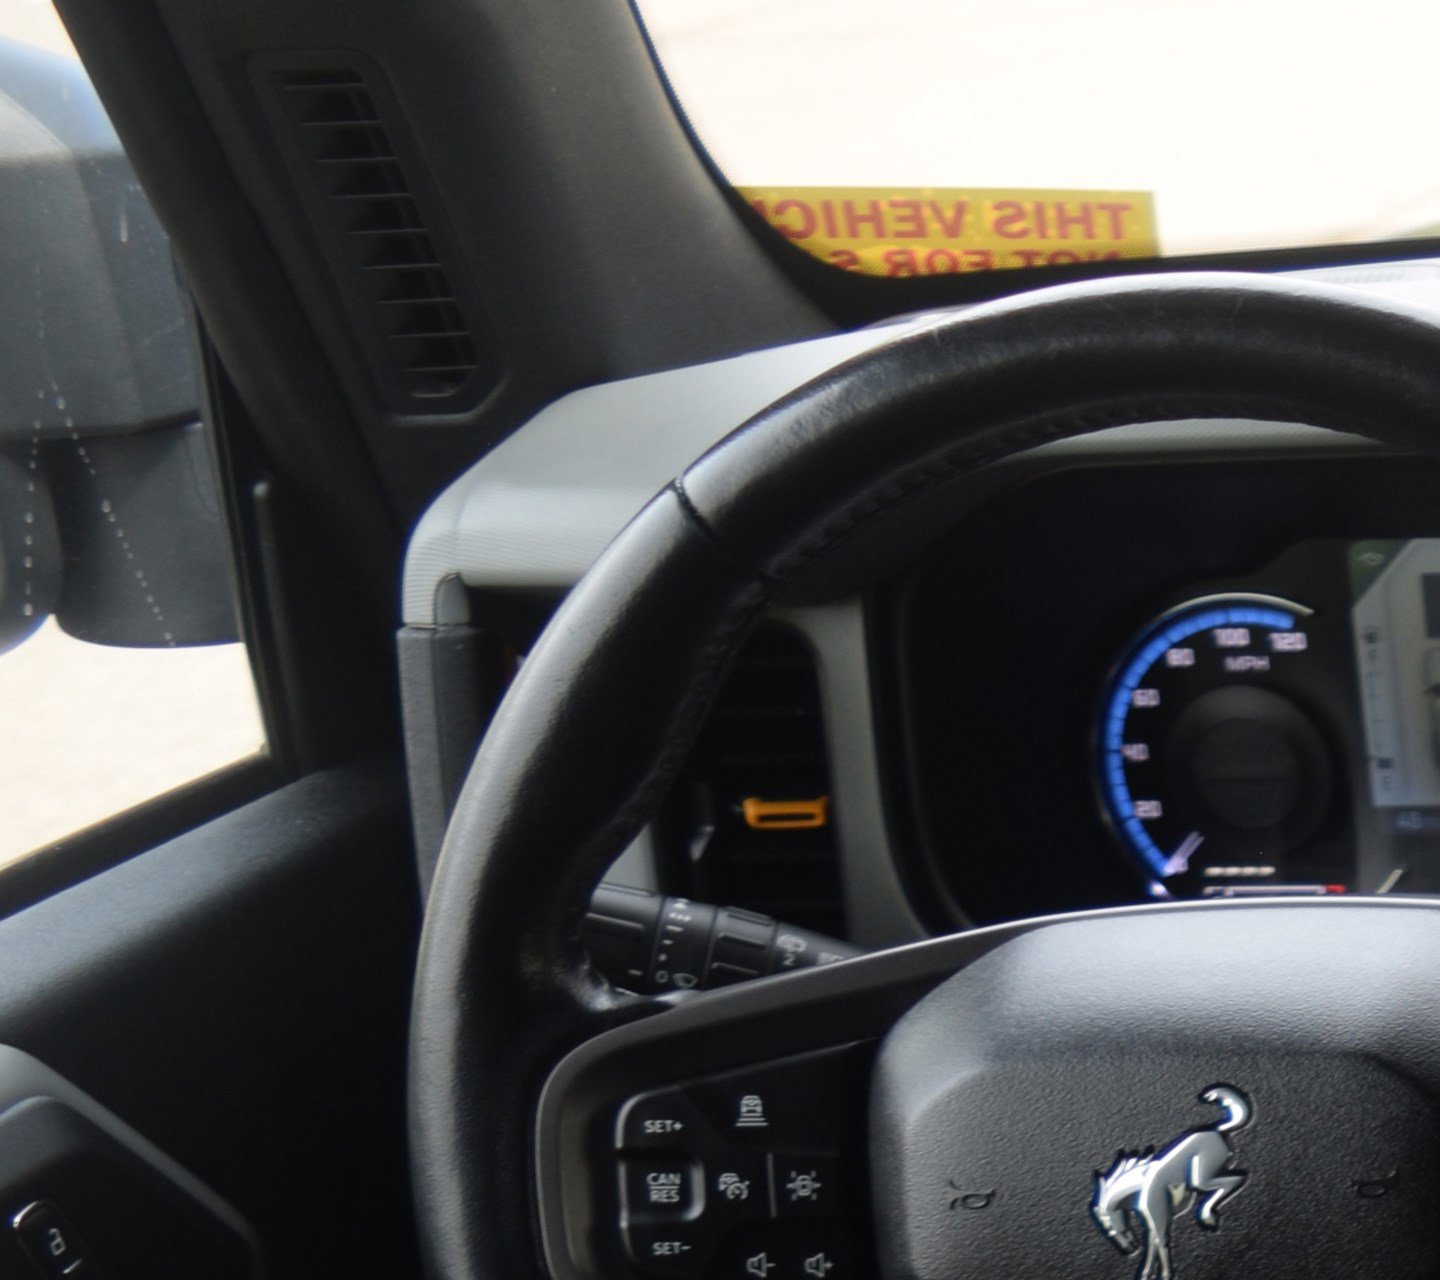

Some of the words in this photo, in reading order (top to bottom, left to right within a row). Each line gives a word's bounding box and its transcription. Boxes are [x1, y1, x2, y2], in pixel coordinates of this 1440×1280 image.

[1214, 627, 1251, 647] 100
[1269, 631, 1308, 652] 120
[1224, 655, 1271, 672] MPH
[1134, 799, 1163, 819] 20
[644, 1119, 684, 1133] SET+
[646, 1172, 682, 1185] CAN
[649, 1190, 680, 1203] RES
